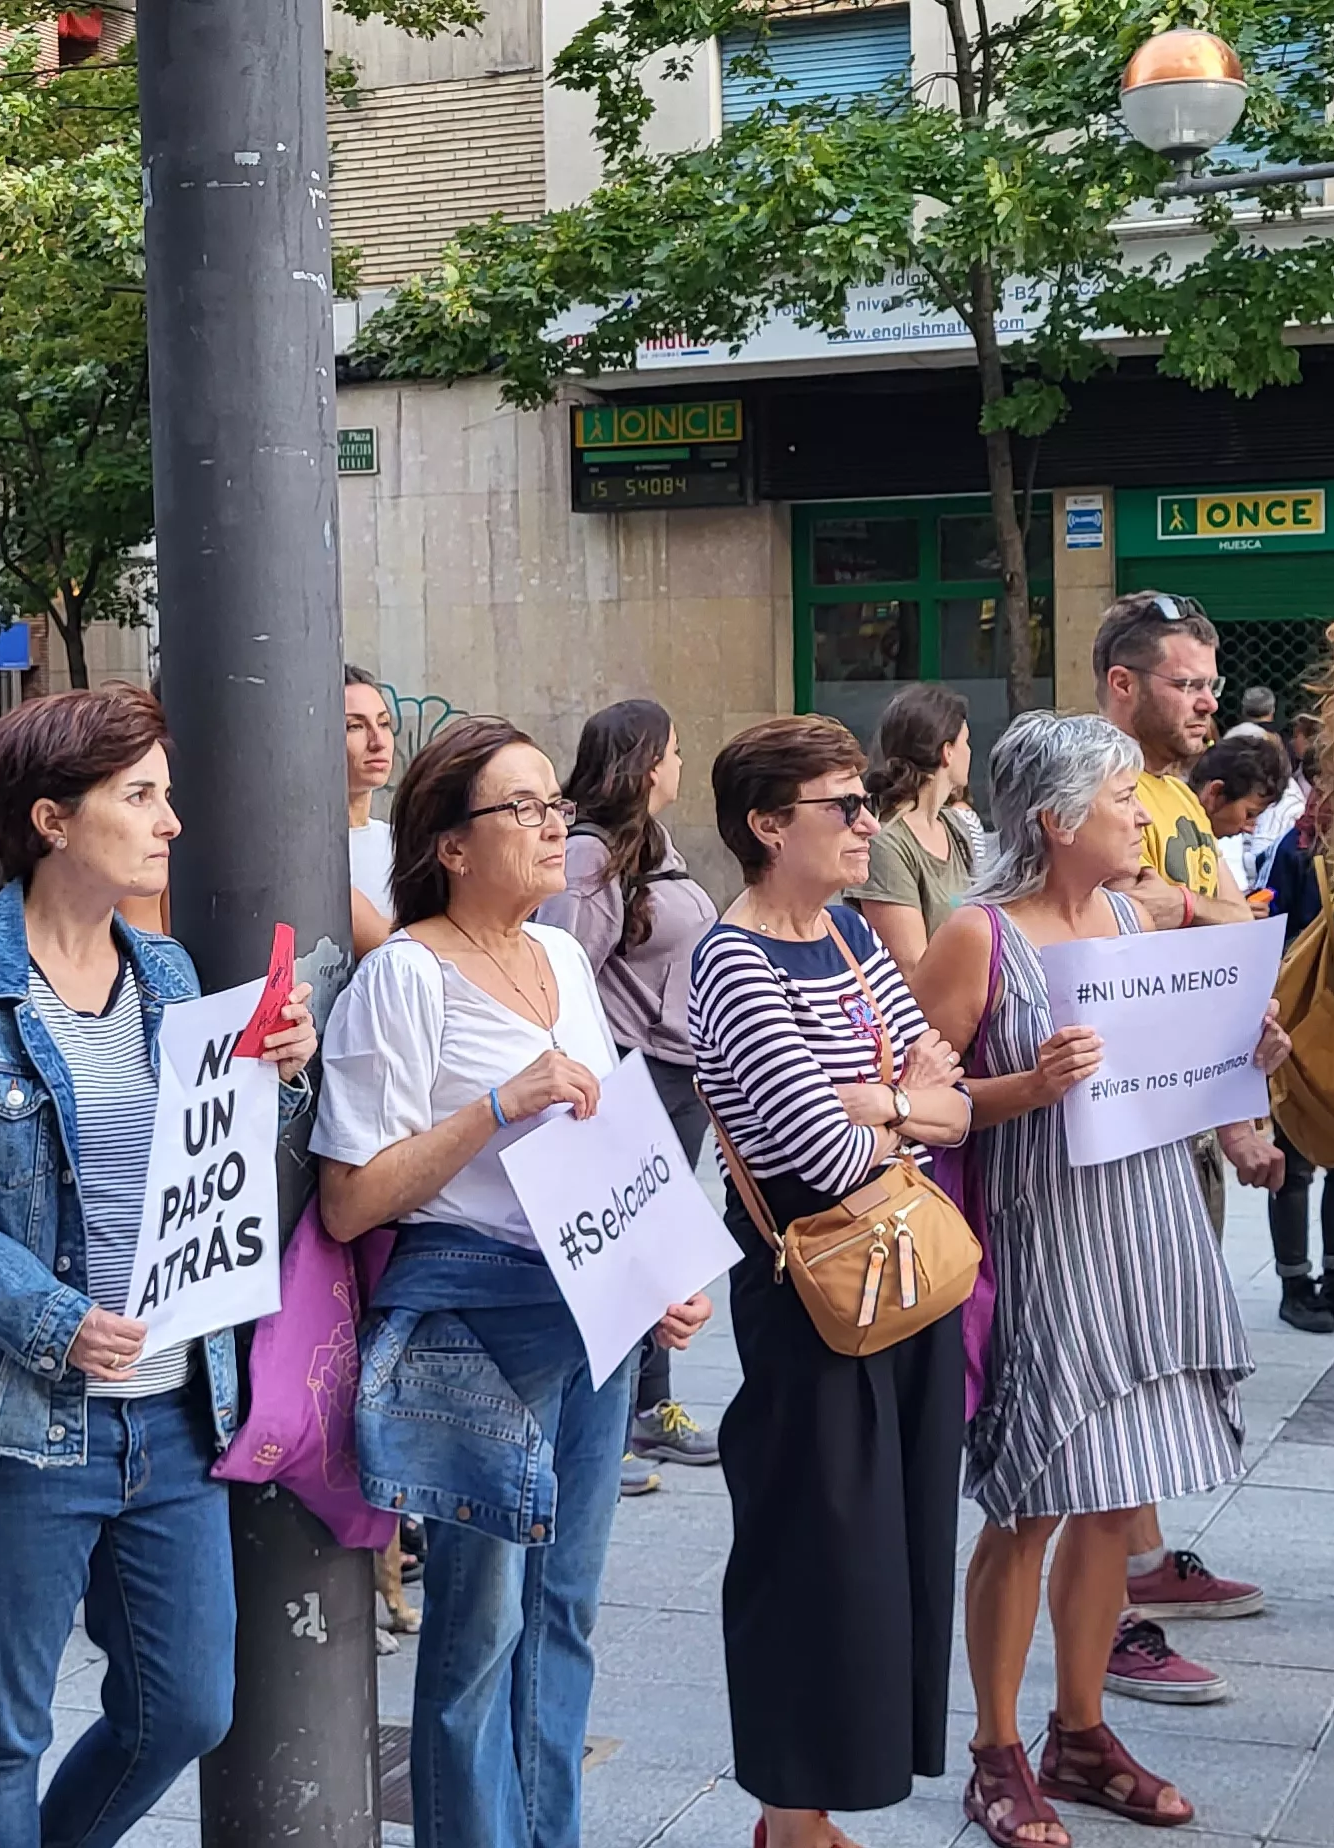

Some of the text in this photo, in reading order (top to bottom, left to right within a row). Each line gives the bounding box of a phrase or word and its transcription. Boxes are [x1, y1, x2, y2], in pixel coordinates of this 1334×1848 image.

[620, 406, 735, 438] ONCE
[590, 477, 687, 498] 15 54084
[1206, 498, 1314, 528] ONCE
[1218, 539, 1262, 550] HUESCA
[1076, 965, 1239, 1004] #NI UNA MENOS
[195, 1029, 246, 1087] NI
[1089, 1076, 1140, 1102] #Vivas
[1146, 1070, 1178, 1090] nos
[183, 1089, 236, 1157] UN
[158, 1151, 246, 1241] PASO
[558, 1141, 671, 1271] #SeAcabó
[135, 1209, 264, 1319] ATRÁS
